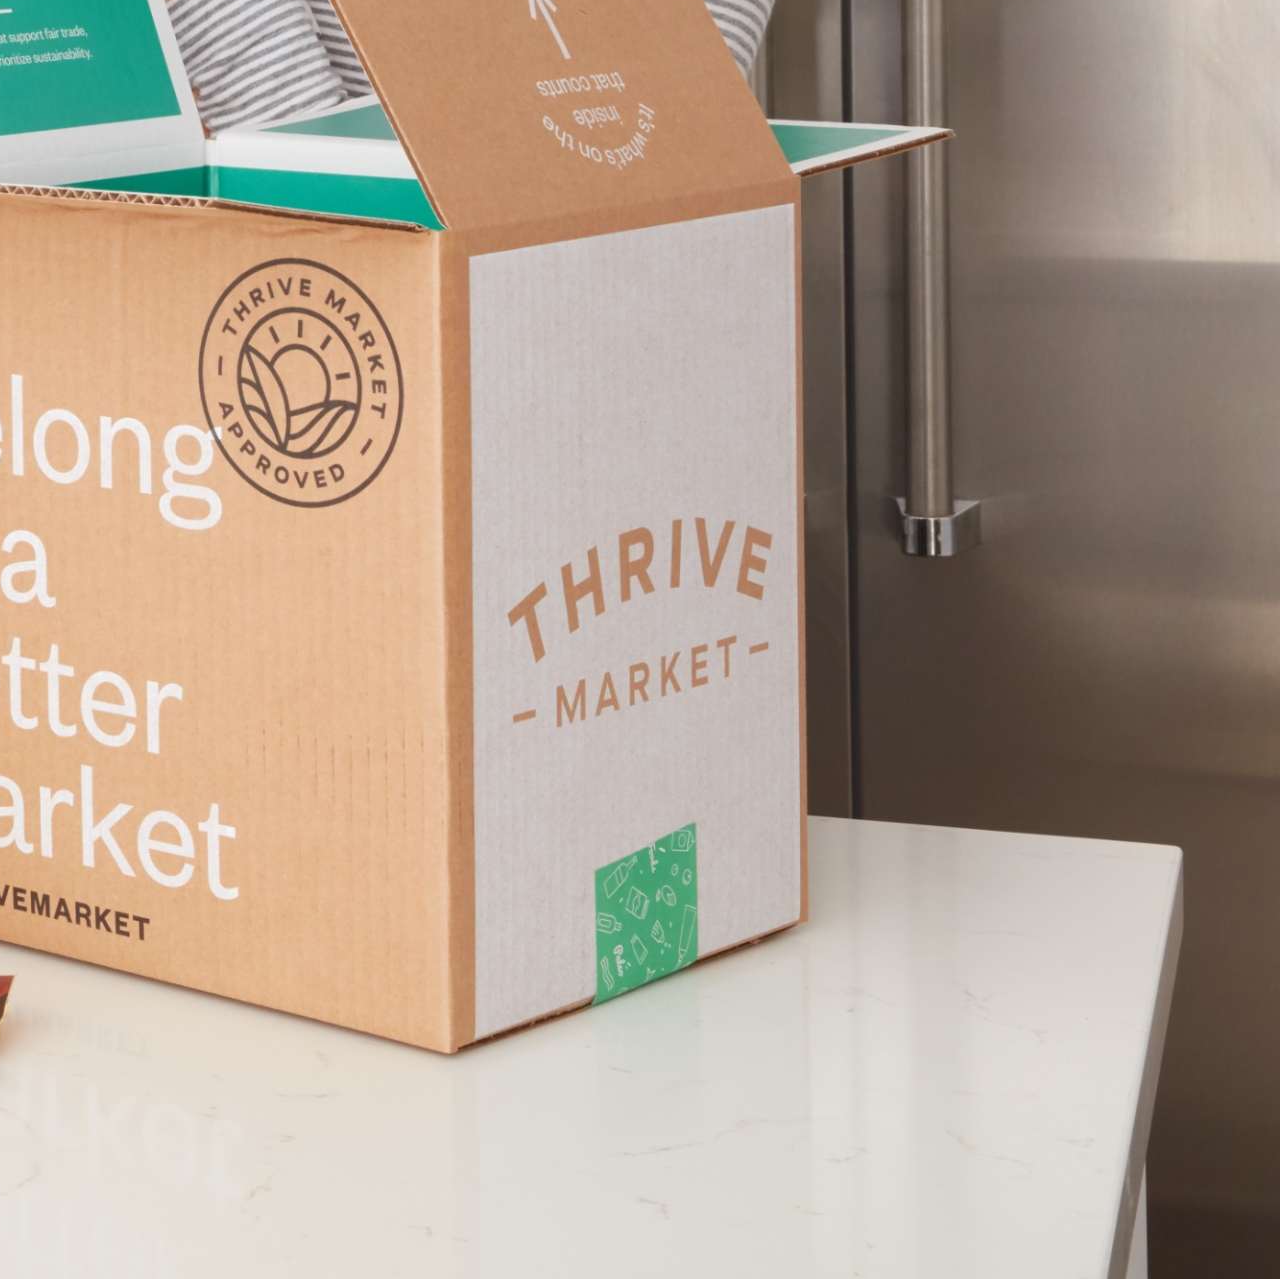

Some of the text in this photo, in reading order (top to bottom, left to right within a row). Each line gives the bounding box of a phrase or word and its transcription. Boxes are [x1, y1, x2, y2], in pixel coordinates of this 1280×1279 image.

[8, 28, 45, 47] support
[44, 26, 60, 39] fair
[60, 25, 88, 39] trade,
[33, 46, 93, 63] sustainability.
[536, 72, 626, 98] that counts
[542, 114, 575, 150] the
[572, 104, 624, 130] inside
[578, 140, 602, 163] on
[605, 132, 648, 170] what's
[222, 277, 388, 420] THRIVE MARKET
[219, 401, 345, 489] APPROVED
[0, 528, 56, 609] a
[507, 517, 773, 664] THRIVE
[555, 635, 738, 728] MARKET
